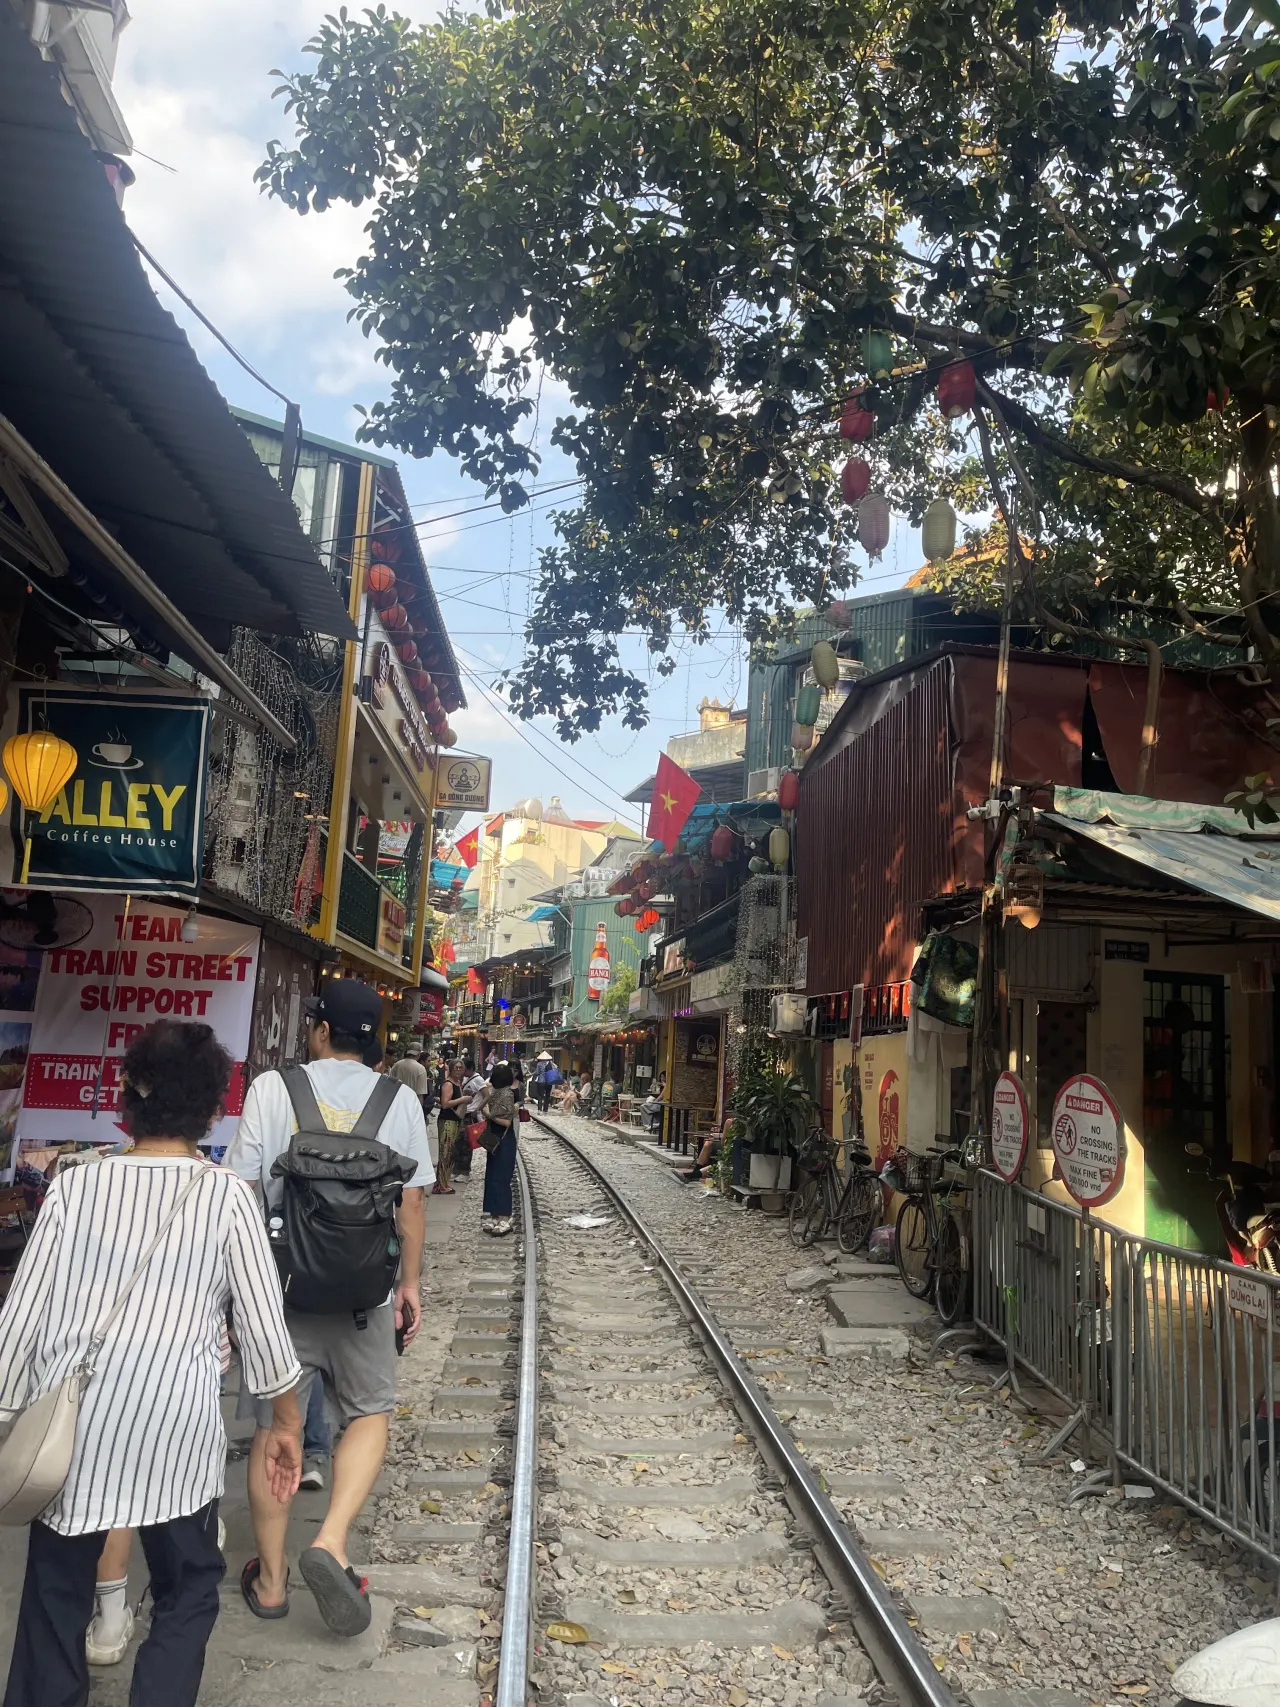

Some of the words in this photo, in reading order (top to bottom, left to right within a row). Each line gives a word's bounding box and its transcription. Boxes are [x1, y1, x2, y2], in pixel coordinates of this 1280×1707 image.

[39, 779, 187, 831] ALLEY
[47, 829, 112, 844] Coffee
[120, 833, 177, 848] House
[48, 947, 137, 976] TRAIN
[145, 952, 252, 981] STREET
[79, 985, 213, 1016] SUPPORT
[41, 1062, 102, 1081] TRAIN
[79, 1085, 121, 1104] GET
[1072, 1098, 1101, 1112] DANGER
[1091, 1125, 1101, 1135] NO
[1080, 1135, 1112, 1151] CROSSING
[1077, 1147, 1089, 1159] THE
[1090, 1151, 1117, 1166] TRACKS
[1069, 1164, 1082, 1176] MAX
[1082, 1168, 1098, 1180] FINE
